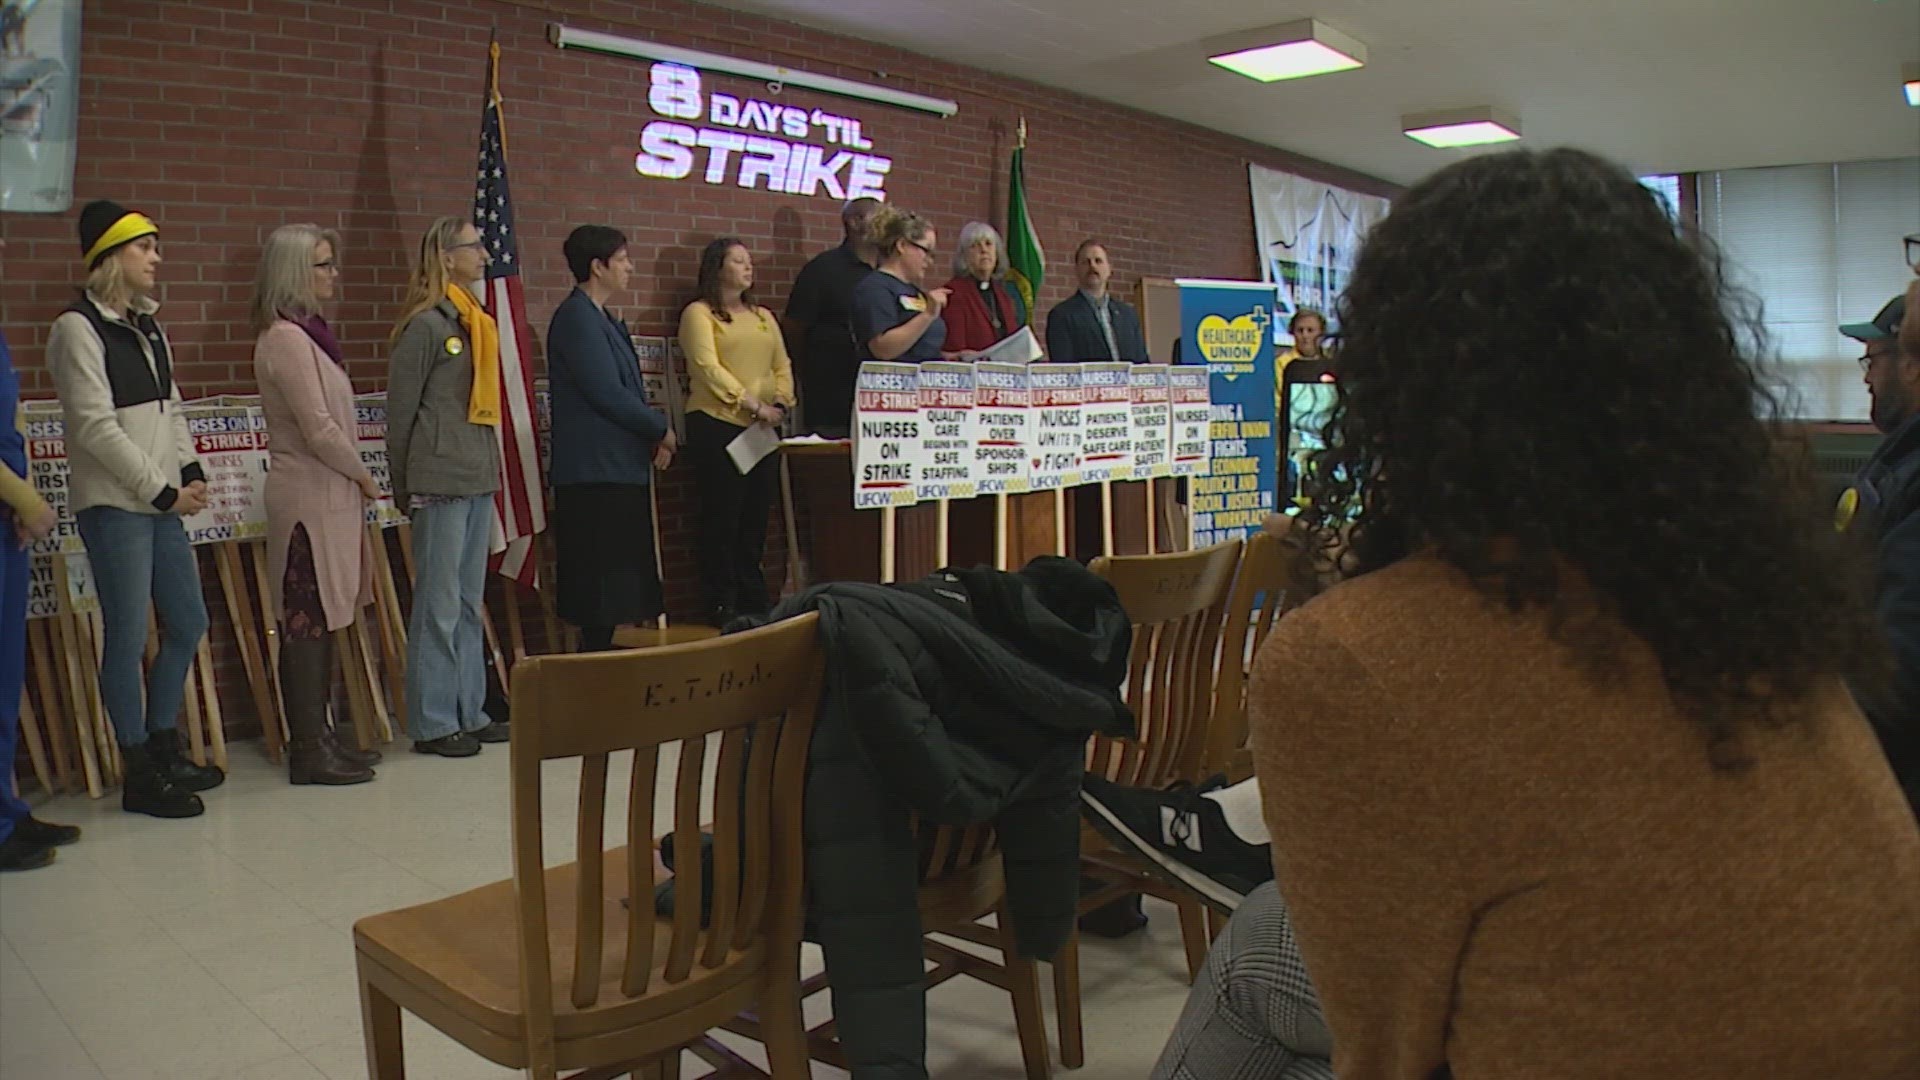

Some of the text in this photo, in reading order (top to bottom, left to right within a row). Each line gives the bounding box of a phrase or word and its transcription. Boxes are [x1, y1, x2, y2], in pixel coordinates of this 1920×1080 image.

[648, 61, 702, 119] 8
[710, 92, 809, 138] DAYS
[635, 120, 892, 202] STRIKE
[1203, 328, 1256, 344] HEALTHCARE
[1210, 346, 1251, 358] UNION
[861, 373, 902, 389] NURSES
[919, 372, 959, 387] NURSES
[977, 372, 1014, 387] NURSES
[1031, 374, 1068, 386] NURSES
[1082, 371, 1114, 384] NURSES
[1171, 374, 1196, 386] NURSES
[939, 391, 973, 407] STRIKE
[998, 390, 1029, 406] STRIKE
[1052, 389, 1082, 404] STRIKE
[1100, 387, 1129, 400] STRIKE
[881, 393, 918, 410] STRIKE
[927, 410, 967, 423] QUALITY
[1153, 406, 1167, 414] WITH
[1175, 410, 1208, 422] NURSES
[190, 418, 226, 433] RSES
[227, 416, 249, 431] ON
[979, 414, 1024, 426] PATIENTS
[1040, 410, 1080, 427] NURSES
[1086, 412, 1127, 424] PATIENTS
[1134, 415, 1166, 427] NURSES
[862, 421, 919, 438] NURSES
[935, 425, 960, 437] CARE
[990, 429, 1016, 440] OVER
[1086, 427, 1128, 439] DESERVE
[1144, 430, 1156, 438] FOR
[1186, 426, 1198, 438] ON
[1241, 421, 1270, 437] UNION
[33, 441, 66, 456] STR
[201, 435, 252, 450] STRIKE
[923, 440, 968, 449] BEGINS WITH
[1083, 440, 1131, 454] SAFE CARE
[1134, 439, 1165, 451] PATIENT
[1177, 441, 1205, 455] STRIKE
[1215, 440, 1247, 457] FIGHTS
[881, 443, 899, 459] ON
[934, 452, 958, 464] SAFE
[1044, 453, 1074, 470] FIGHT
[1135, 453, 1164, 466] SAFETY
[863, 463, 911, 481] STRIKE
[922, 467, 969, 480] STAFFING
[987, 463, 1017, 475] SHIPS
[1239, 475, 1257, 491] AND
[1193, 491, 1271, 512] SOCIAL JUSTICE IN
